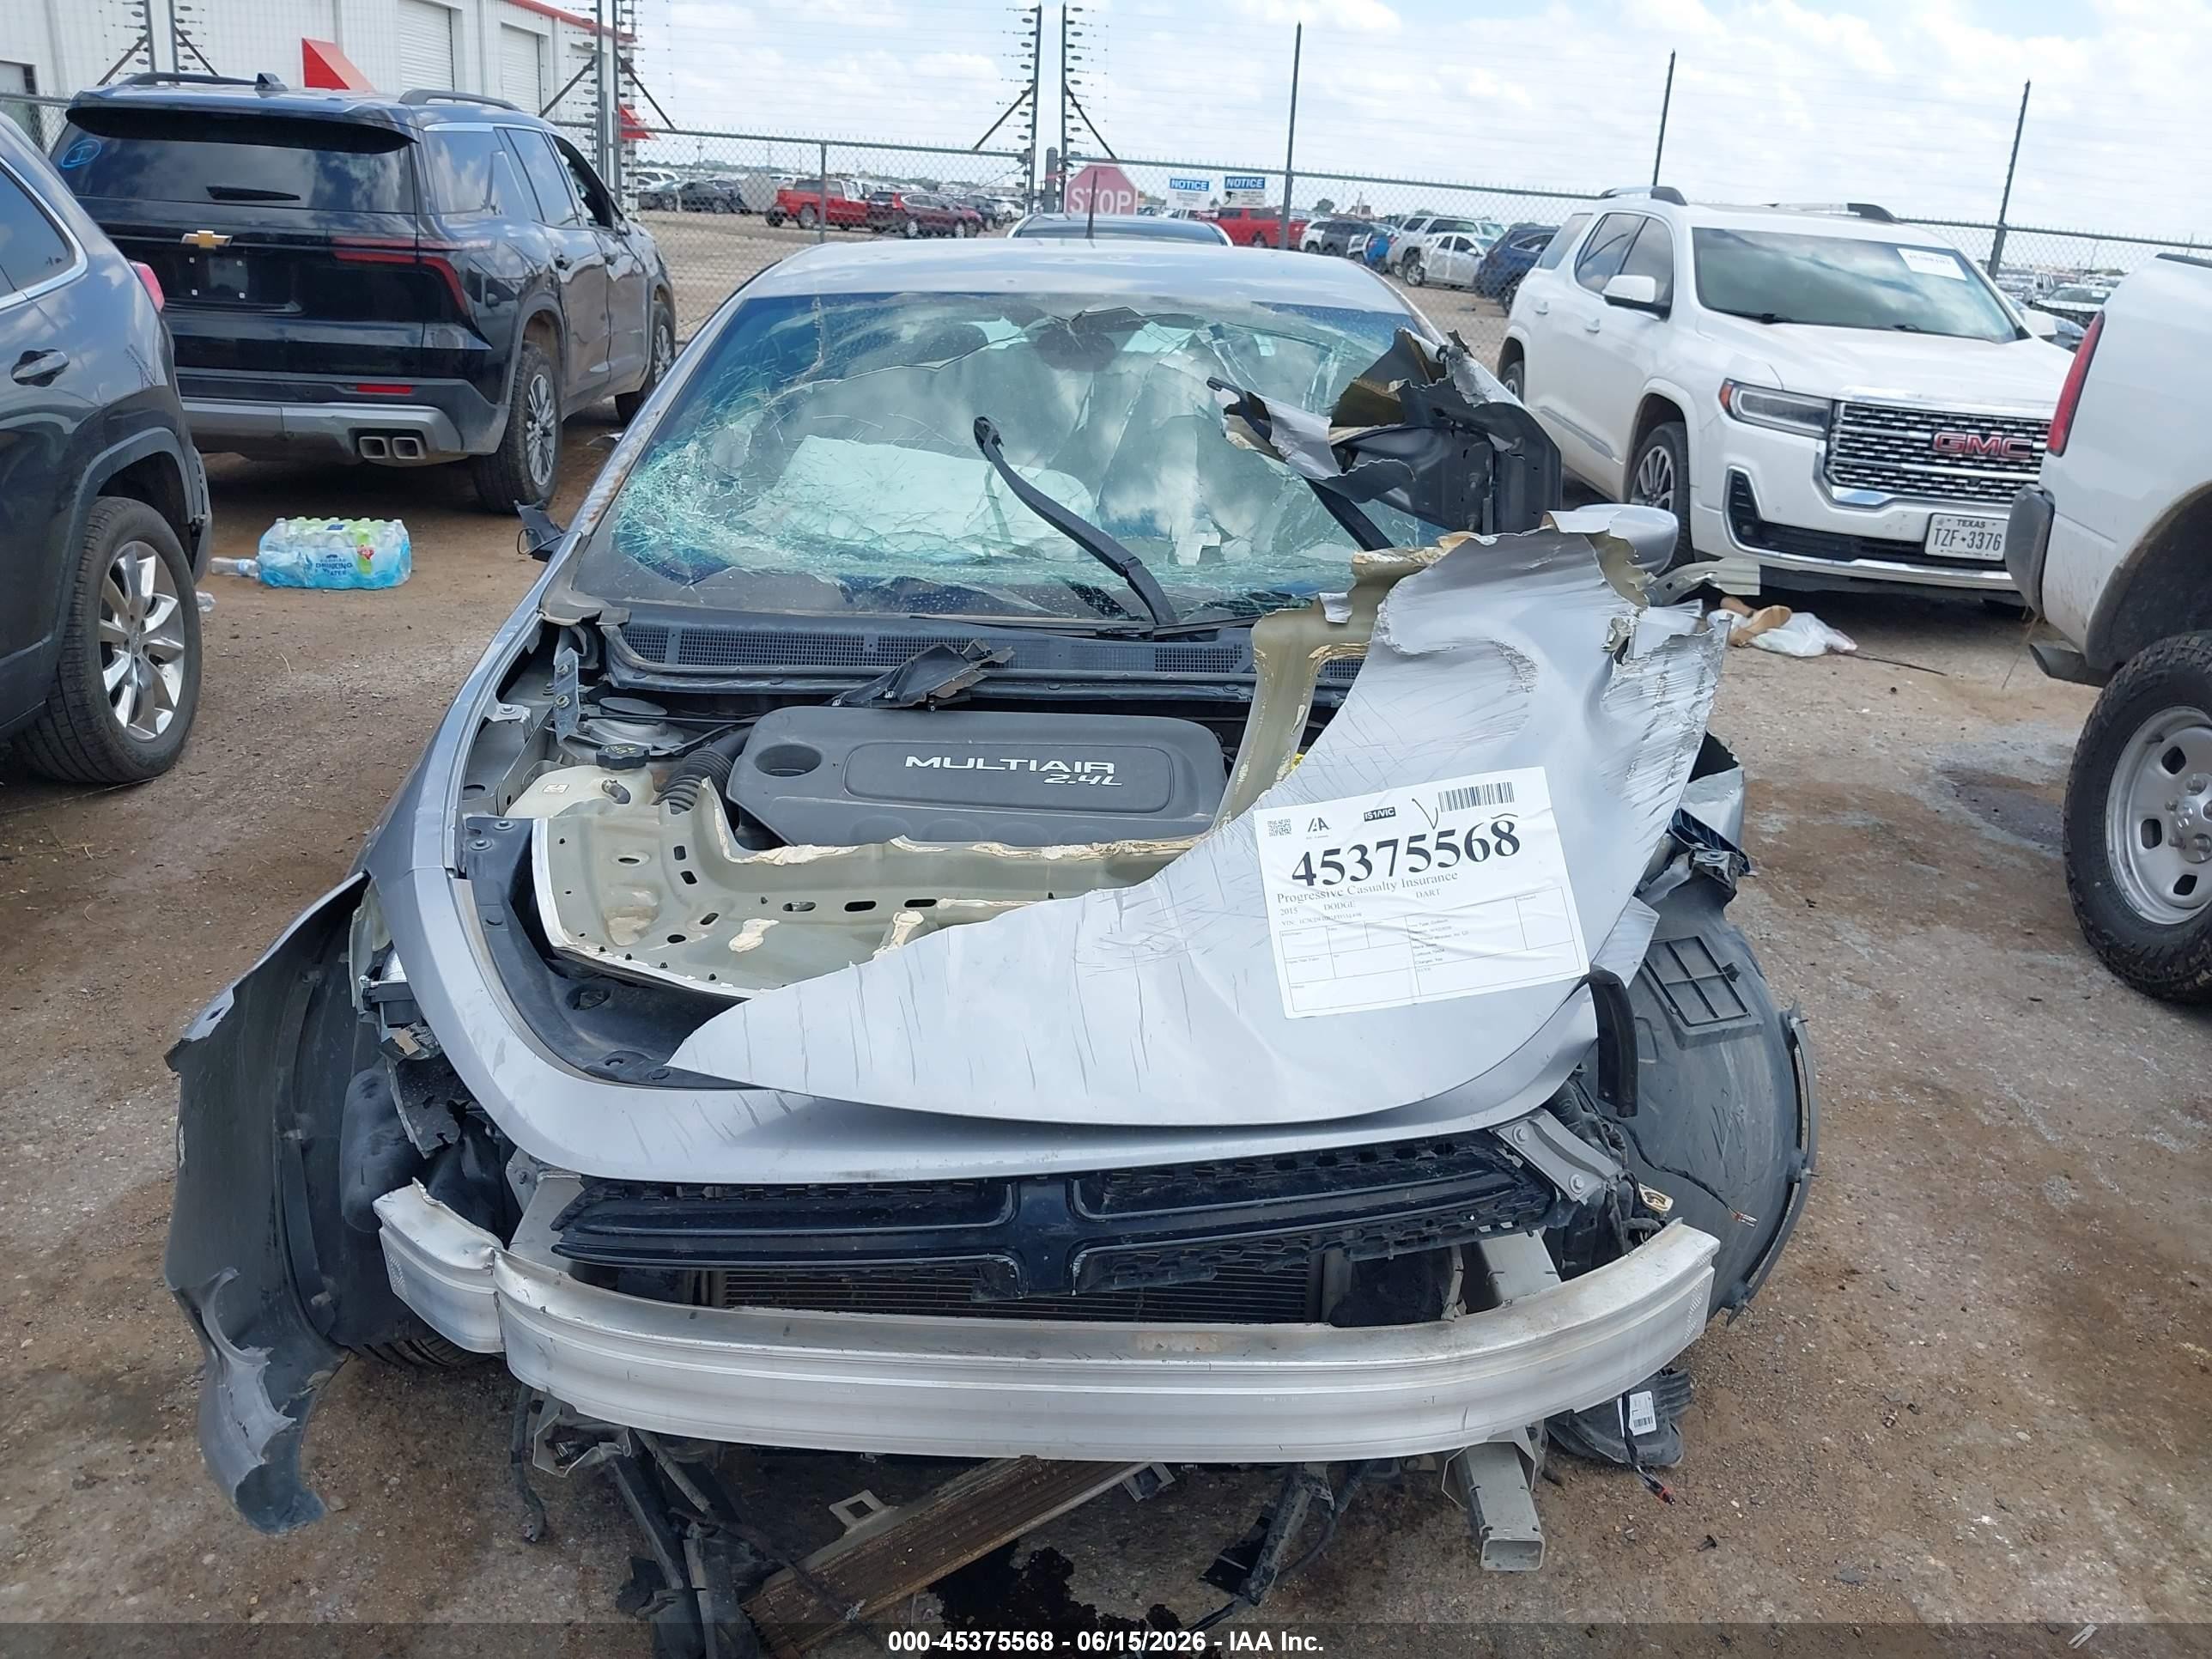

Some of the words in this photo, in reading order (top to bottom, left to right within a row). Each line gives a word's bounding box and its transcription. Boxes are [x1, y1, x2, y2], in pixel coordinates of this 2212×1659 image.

[1170, 179, 1207, 191] NOTICE
[1225, 177, 1264, 188] NOTICE
[1070, 187, 1132, 214] STOP
[1933, 431, 2033, 459] GMC
[1956, 519, 1986, 529] TEXAS
[905, 756, 1115, 774] MULTIAIR
[1043, 774, 1123, 786] 2.4L
[1291, 819, 1521, 886] 45375568
[1277, 888, 1344, 904] Progressive
[1346, 880, 1397, 895] Casualty
[1401, 871, 1458, 888] Insurance
[1279, 908, 1298, 916] 2015
[1323, 901, 1356, 912] DODGE
[1415, 888, 1441, 899] DART
